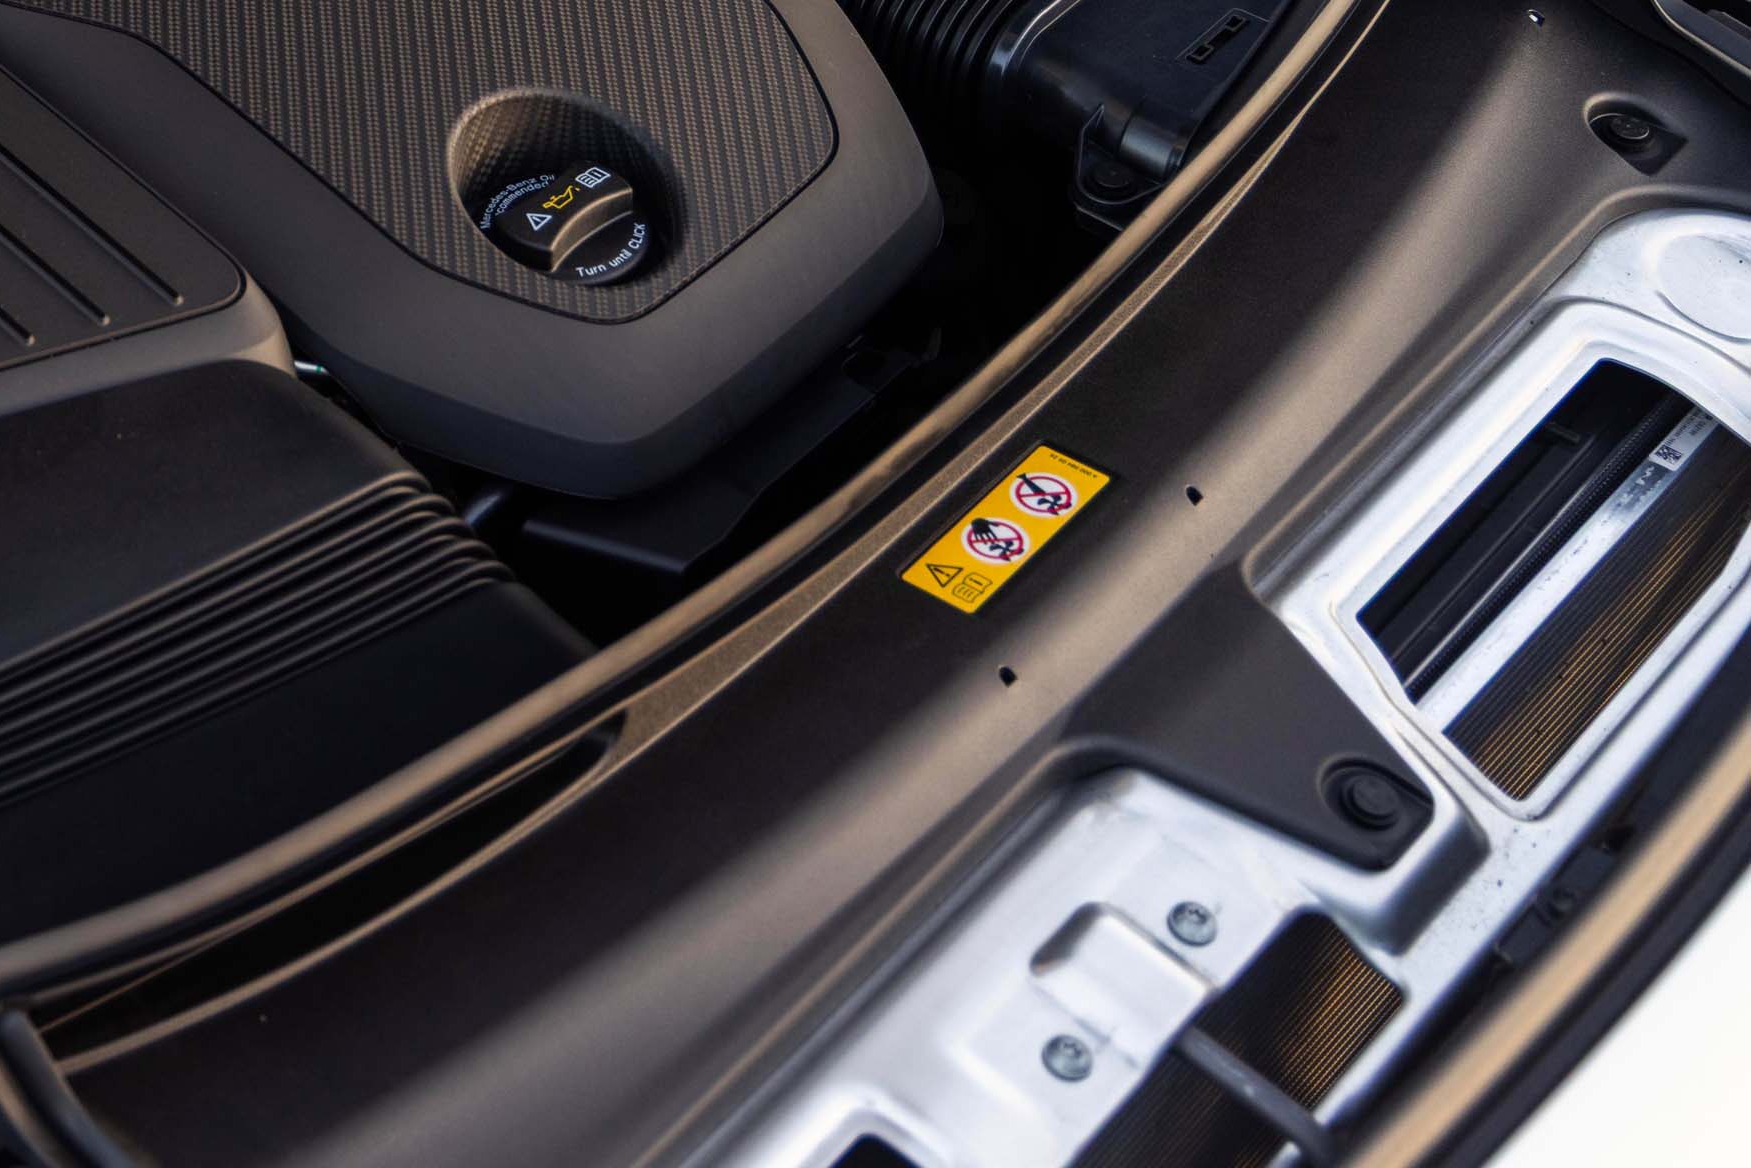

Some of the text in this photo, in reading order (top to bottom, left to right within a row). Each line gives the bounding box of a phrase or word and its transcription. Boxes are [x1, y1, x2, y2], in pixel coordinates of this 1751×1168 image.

[576, 223, 646, 278] Turn until CLICK
